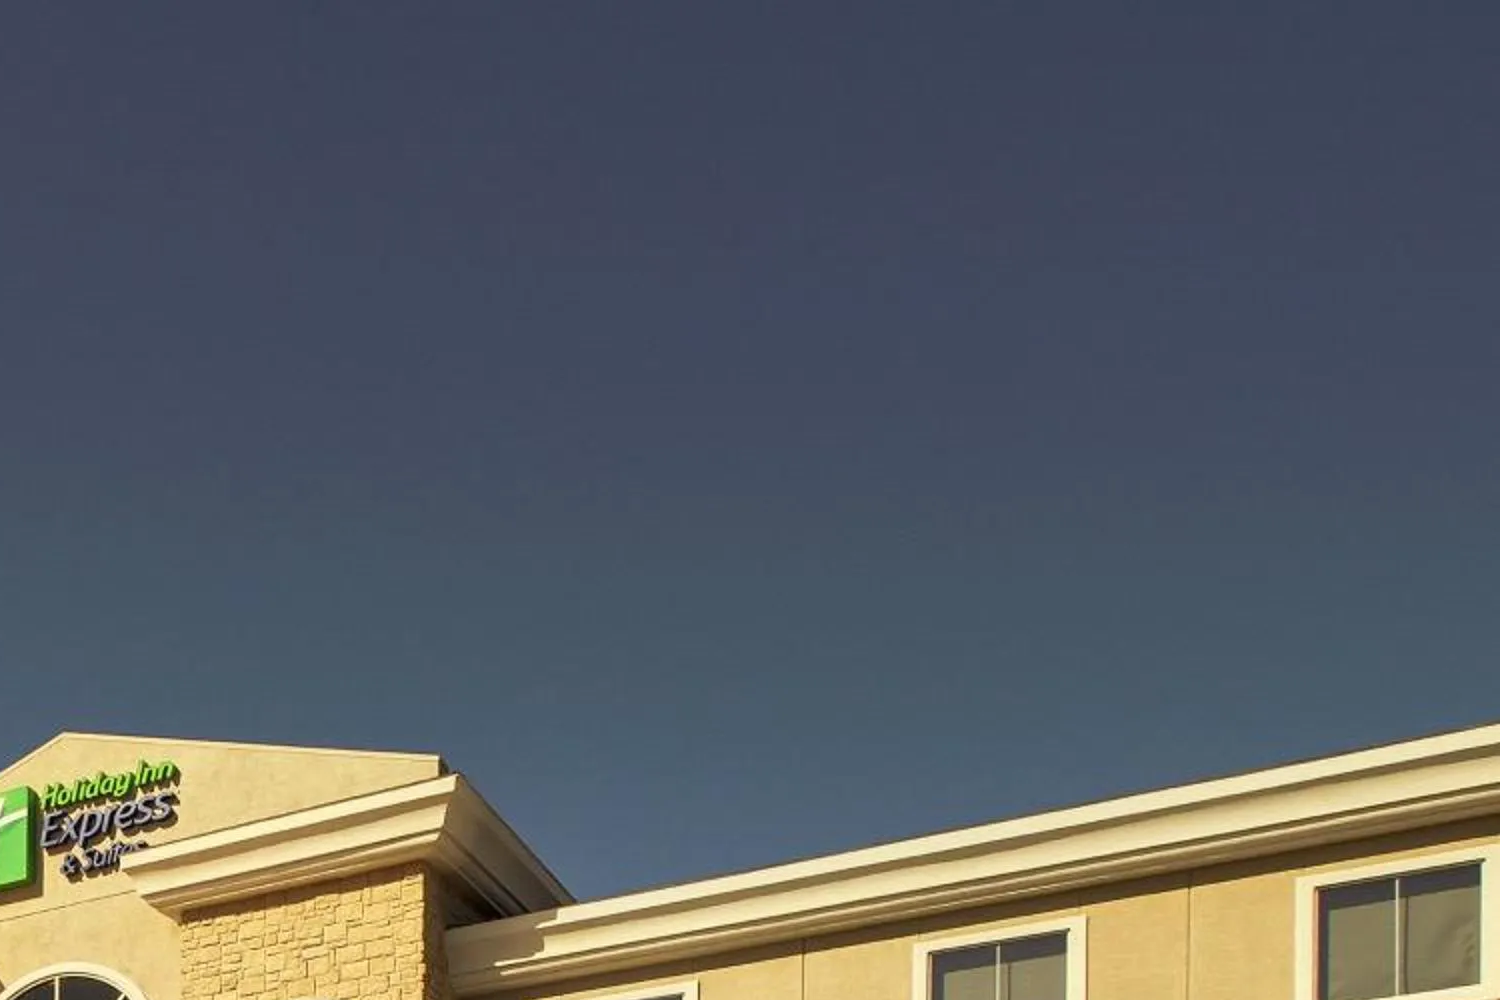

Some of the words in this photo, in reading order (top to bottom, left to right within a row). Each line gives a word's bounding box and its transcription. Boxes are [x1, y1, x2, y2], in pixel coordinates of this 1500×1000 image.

[40, 773, 132, 809] Holiday
[135, 760, 174, 787] Inn
[40, 791, 173, 847] Express
[61, 852, 77, 874] &
